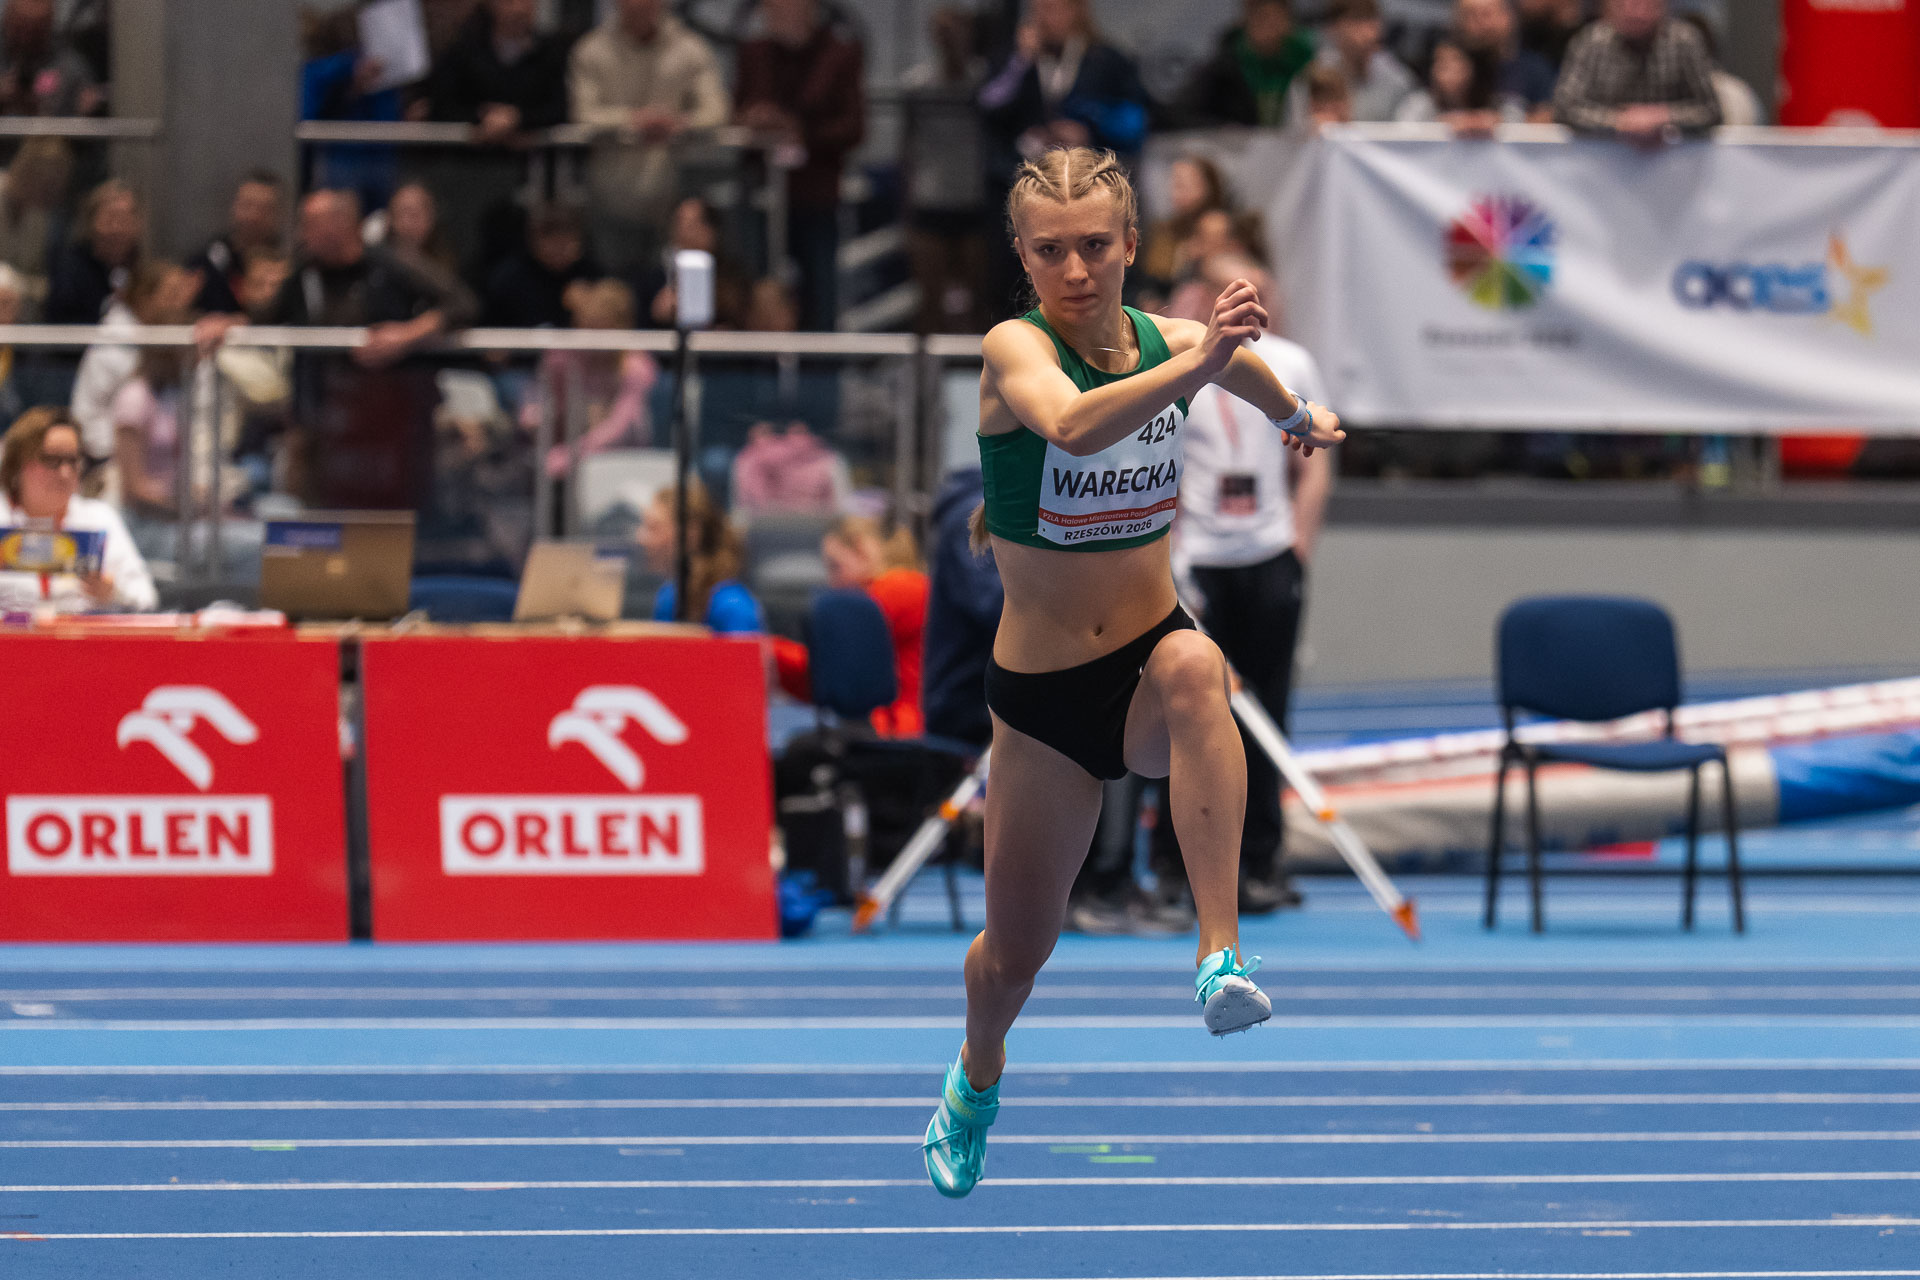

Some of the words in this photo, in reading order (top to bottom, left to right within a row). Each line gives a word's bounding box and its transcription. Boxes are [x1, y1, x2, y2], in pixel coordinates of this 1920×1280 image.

[1138, 411, 1176, 445] 424
[1053, 459, 1176, 498] WARECKA
[1043, 512, 1059, 522] PZLA
[1061, 516, 1088, 525] Halowe
[1089, 512, 1129, 522] Mistrzostwa
[1064, 523, 1124, 540] RZESZÓW
[1126, 519, 1152, 533] 2026
[26, 812, 250, 857] ORLEN
[461, 812, 679, 857] ORLEN
